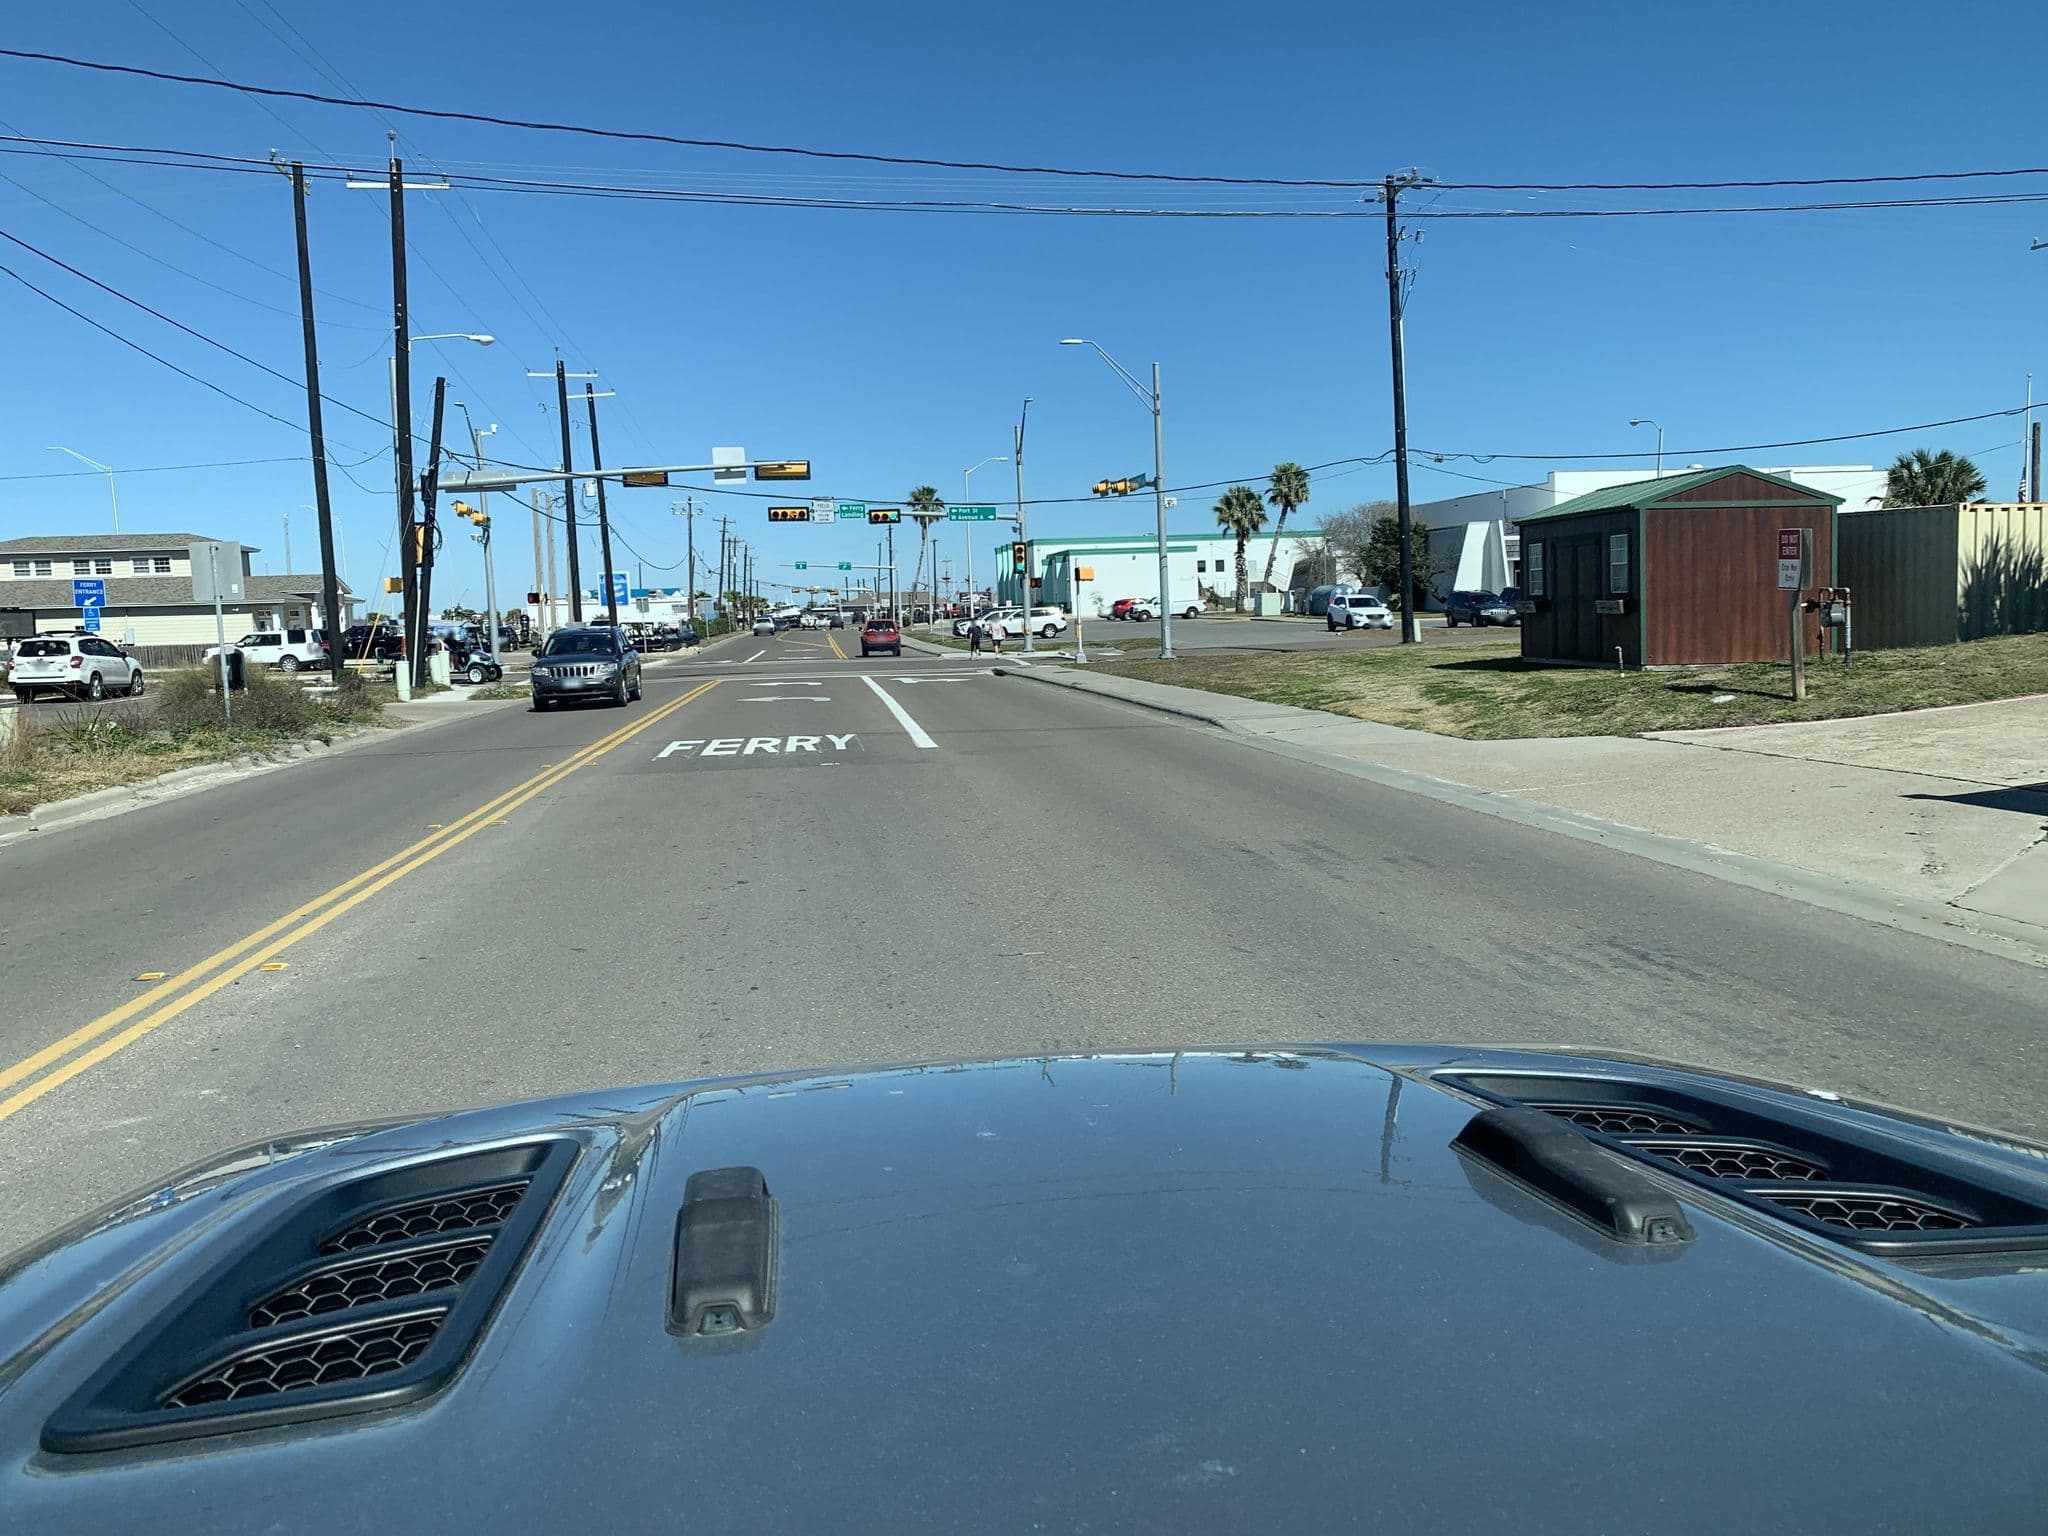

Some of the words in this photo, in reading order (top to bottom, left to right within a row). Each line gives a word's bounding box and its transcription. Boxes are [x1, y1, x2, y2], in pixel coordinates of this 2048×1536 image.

[1781, 535, 1788, 543] DO
[1789, 535, 1798, 543] NOT
[1783, 547, 1797, 555] ENTER
[656, 734, 856, 759] FERRY
